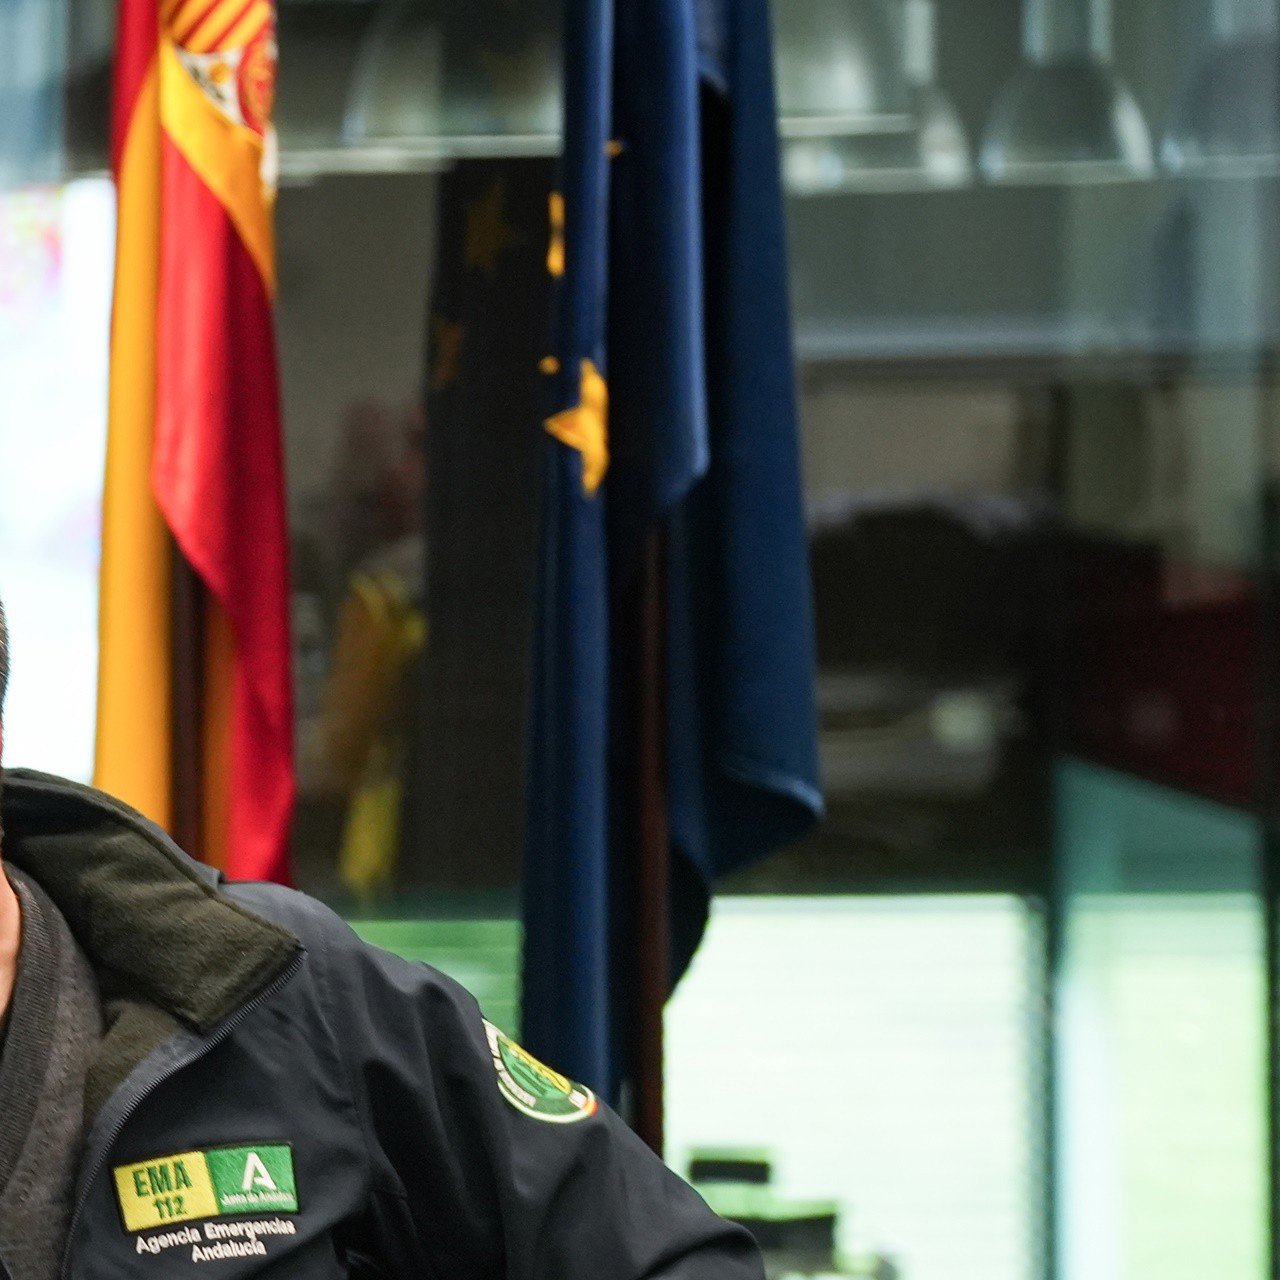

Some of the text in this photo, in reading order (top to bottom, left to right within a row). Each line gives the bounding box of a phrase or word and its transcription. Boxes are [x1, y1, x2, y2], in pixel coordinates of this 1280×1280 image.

[132, 1160, 193, 1197] EMA
[153, 1195, 188, 1219] 112
[136, 1217, 296, 1254] Agencia Emergencias
